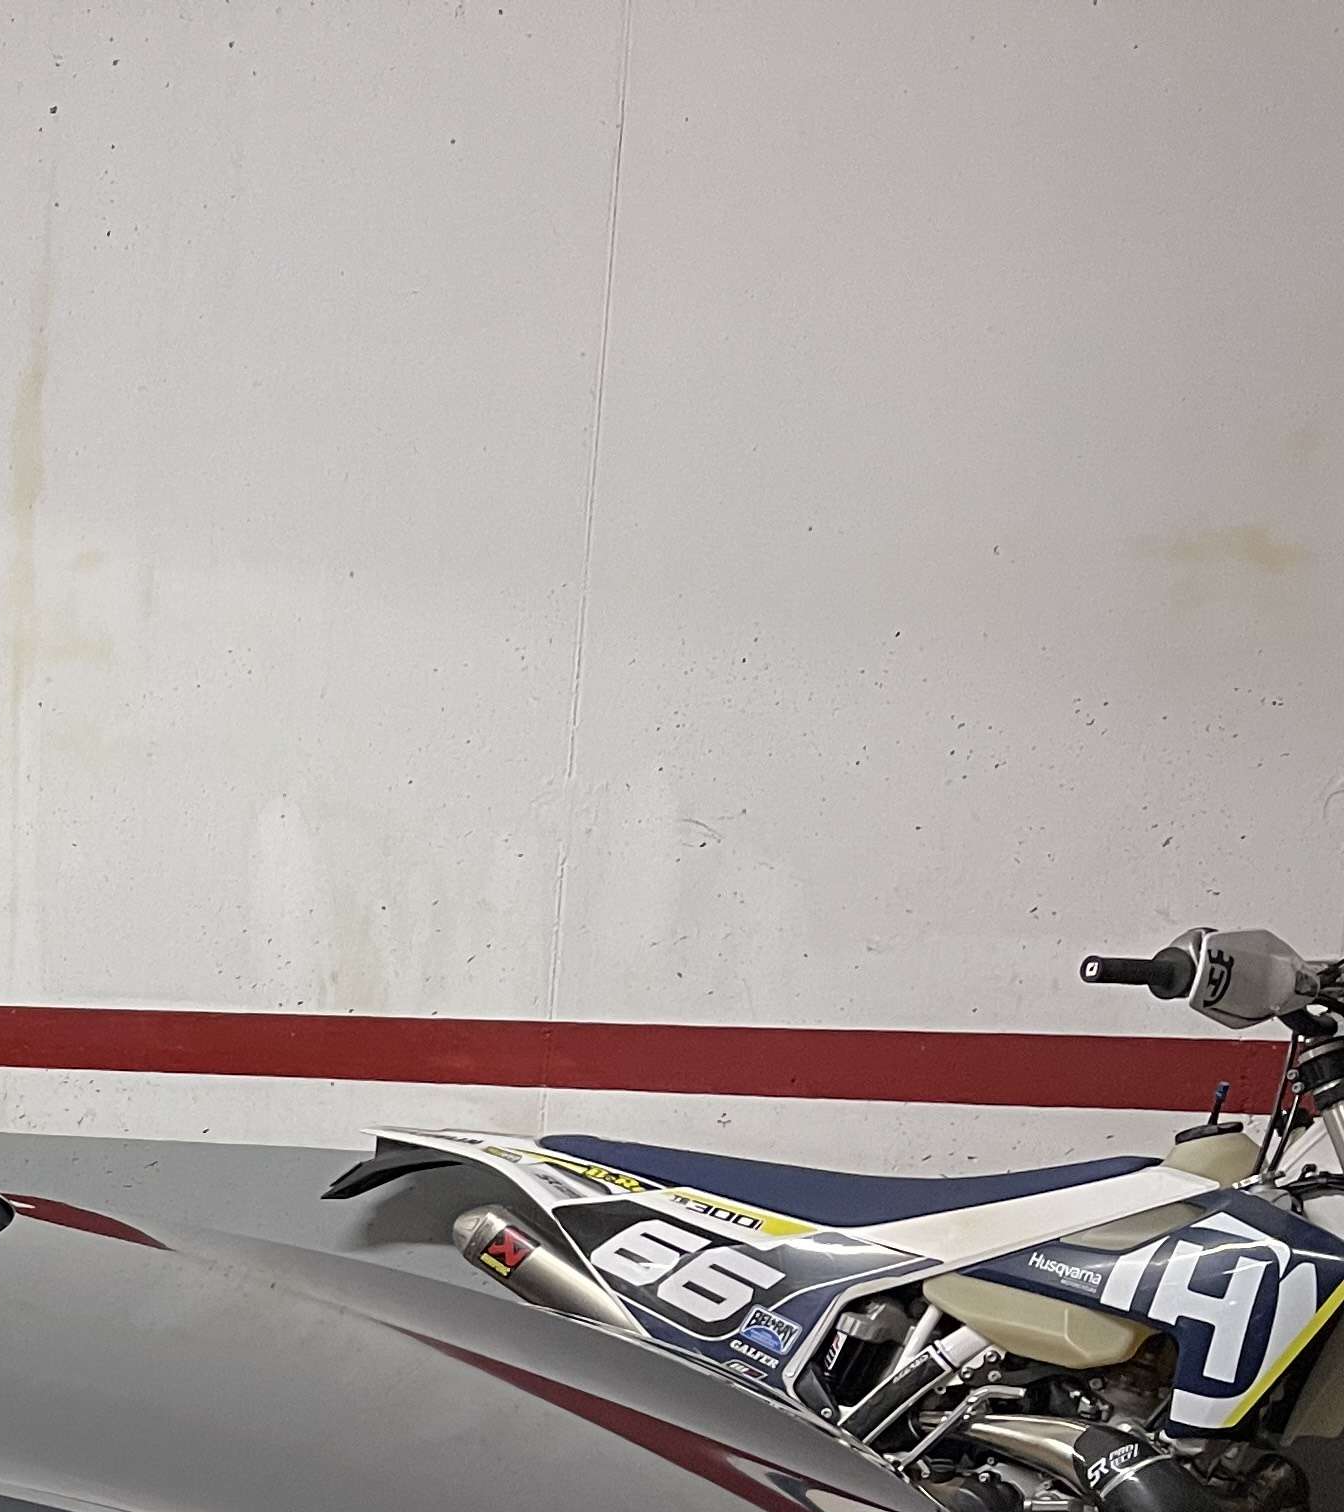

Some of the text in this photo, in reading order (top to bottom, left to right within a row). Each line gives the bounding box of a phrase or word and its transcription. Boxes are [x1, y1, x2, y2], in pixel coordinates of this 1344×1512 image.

[590, 1219, 787, 1323] 66
[1028, 1252, 1102, 1285] Husqvarna
[729, 1339, 780, 1369] GALFER
